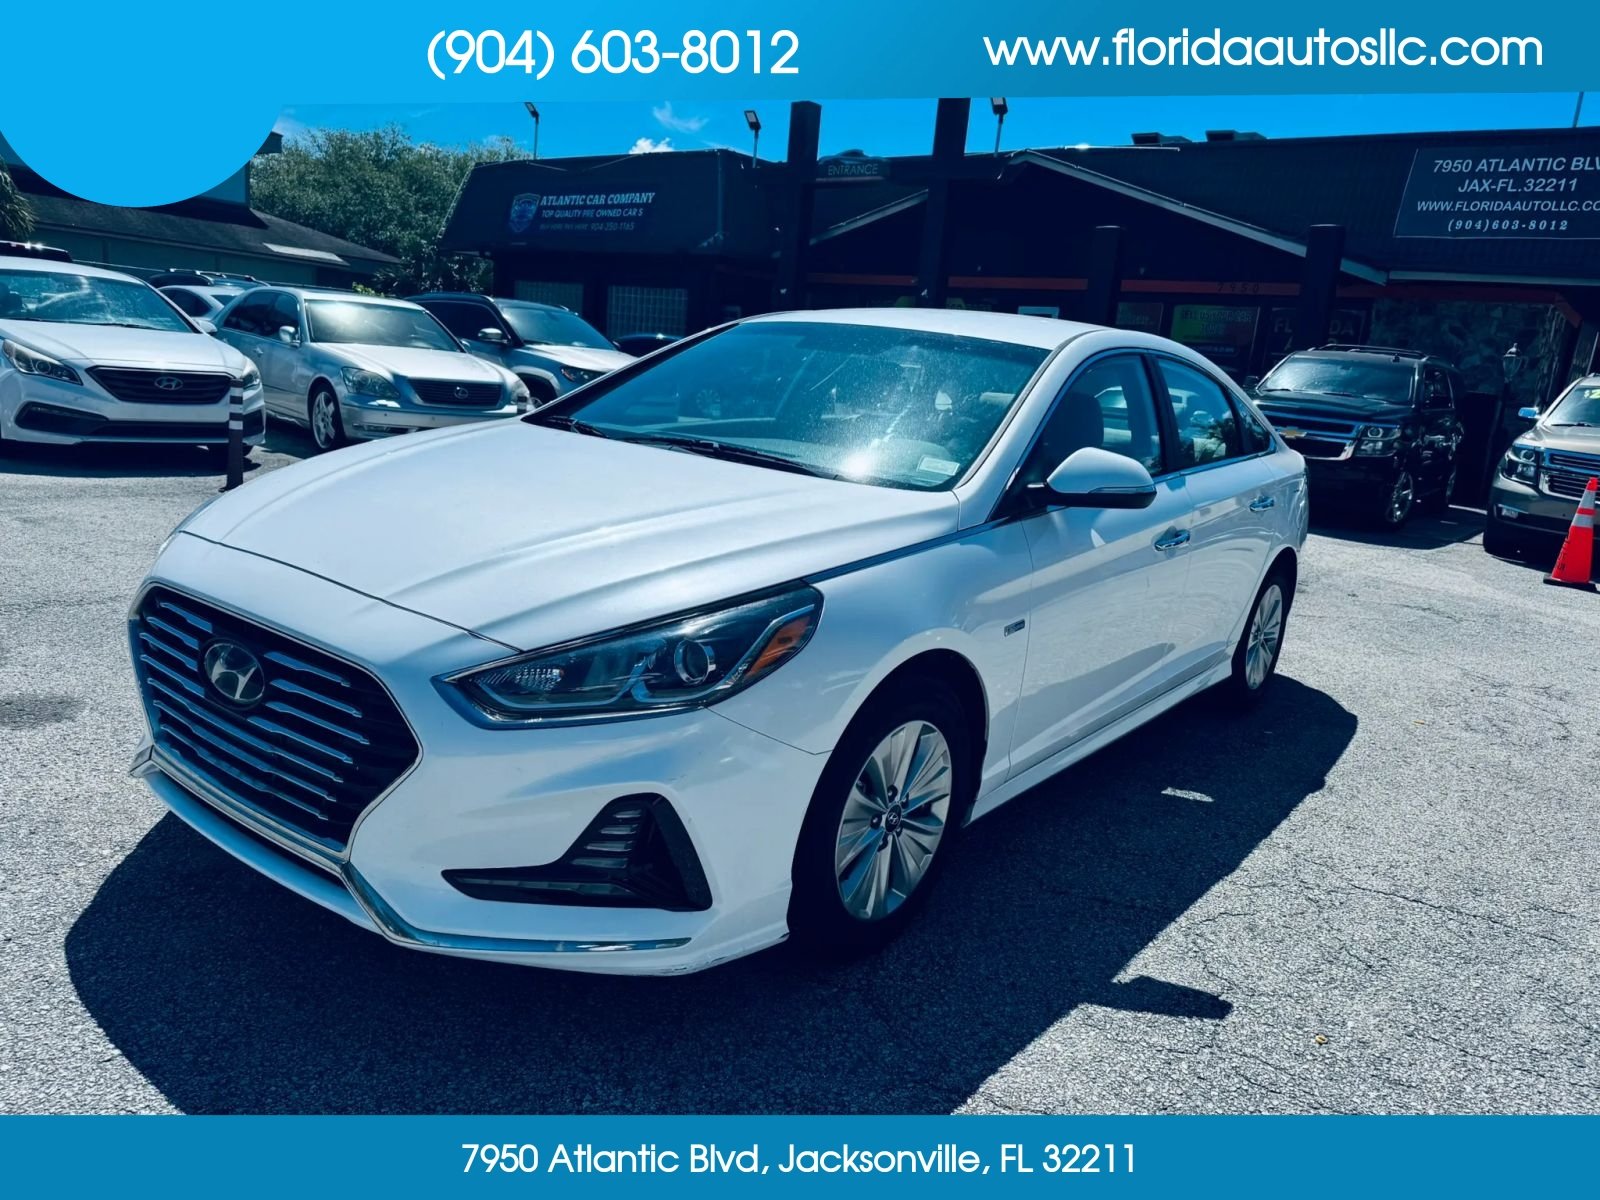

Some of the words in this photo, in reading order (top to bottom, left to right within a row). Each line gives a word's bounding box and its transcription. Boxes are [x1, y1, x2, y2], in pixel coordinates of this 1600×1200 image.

[827, 163, 879, 176] ENTRANCE
[1433, 159, 1472, 173] 7950
[1475, 157, 1567, 172] ATLANTIC
[1458, 178, 1578, 193] JAX-FL.32211
[540, 195, 586, 206] ATLANTIC
[586, 194, 606, 205] CAR
[607, 192, 656, 205] COMPANY
[541, 210, 553, 218] TOP
[554, 209, 581, 218] QUALITY
[596, 208, 622, 217] OWNED
[1447, 218, 1569, 233] (904)603-8012
